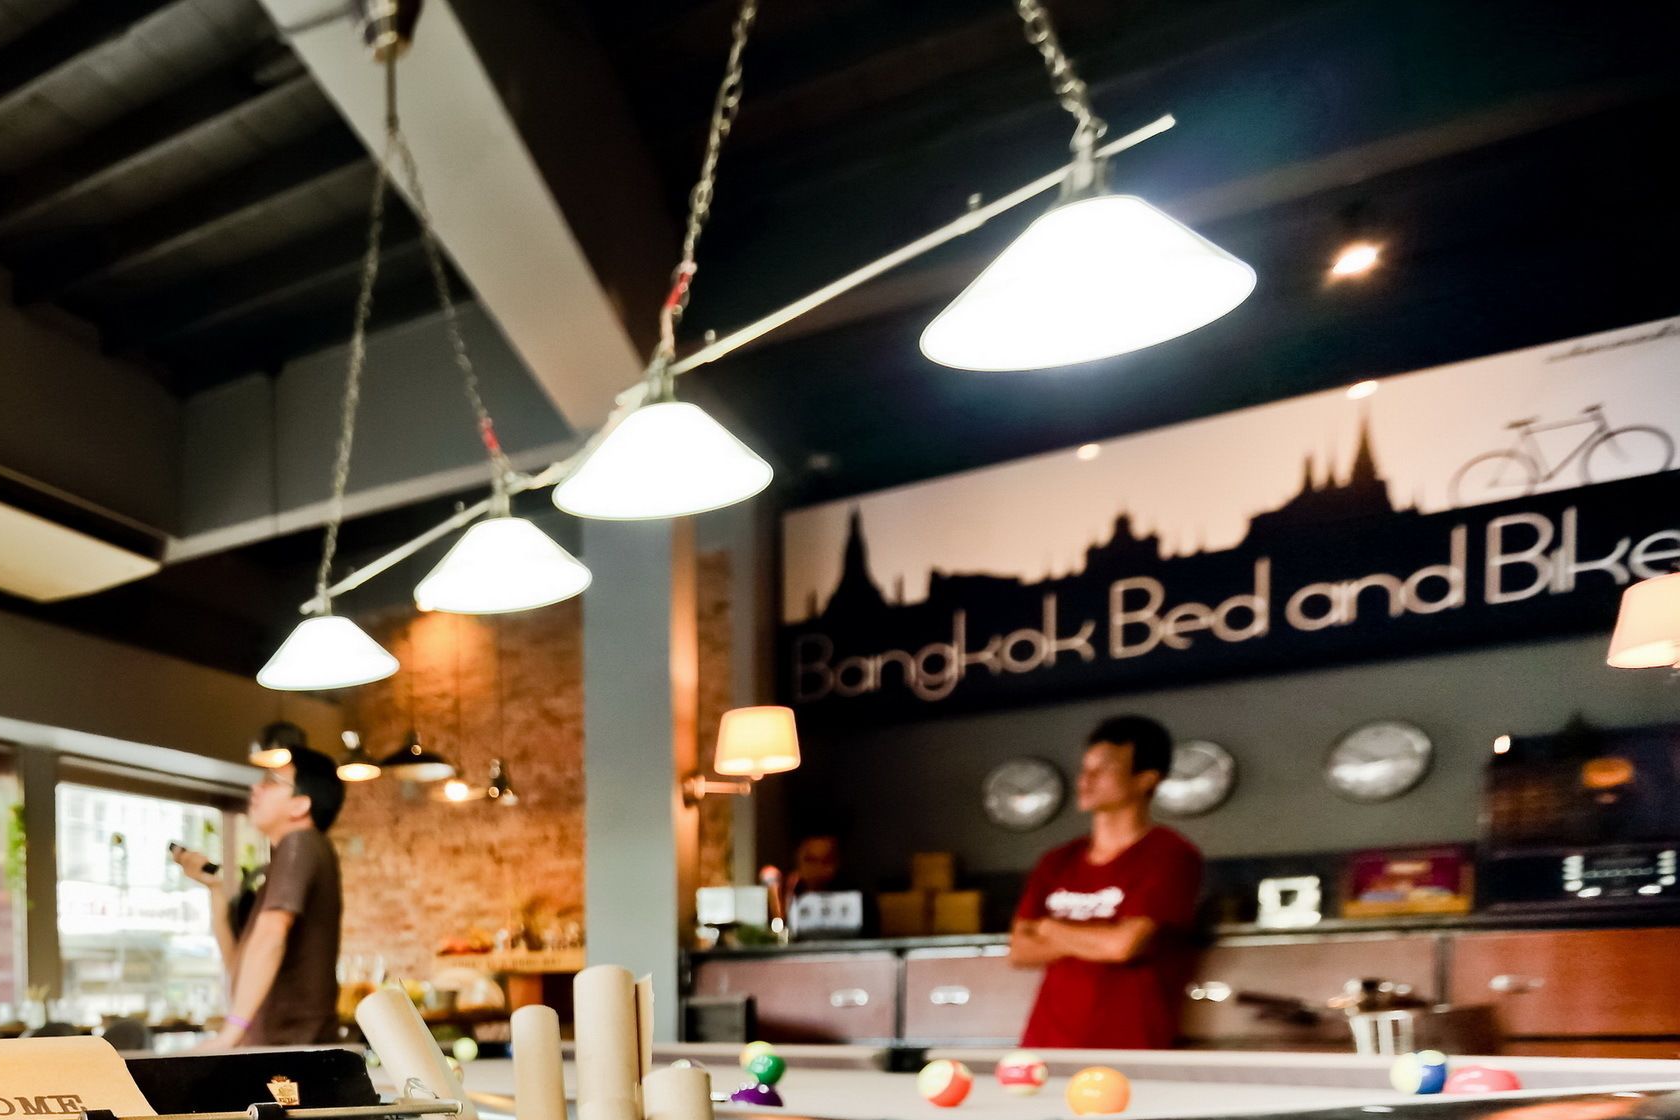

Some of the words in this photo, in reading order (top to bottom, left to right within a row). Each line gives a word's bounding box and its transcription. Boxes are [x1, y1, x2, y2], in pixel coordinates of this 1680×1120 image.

[794, 592, 1096, 701] Bangkok
[1108, 556, 1271, 660] Bed
[1286, 523, 1468, 631] and
[1485, 504, 1680, 605] Bike
